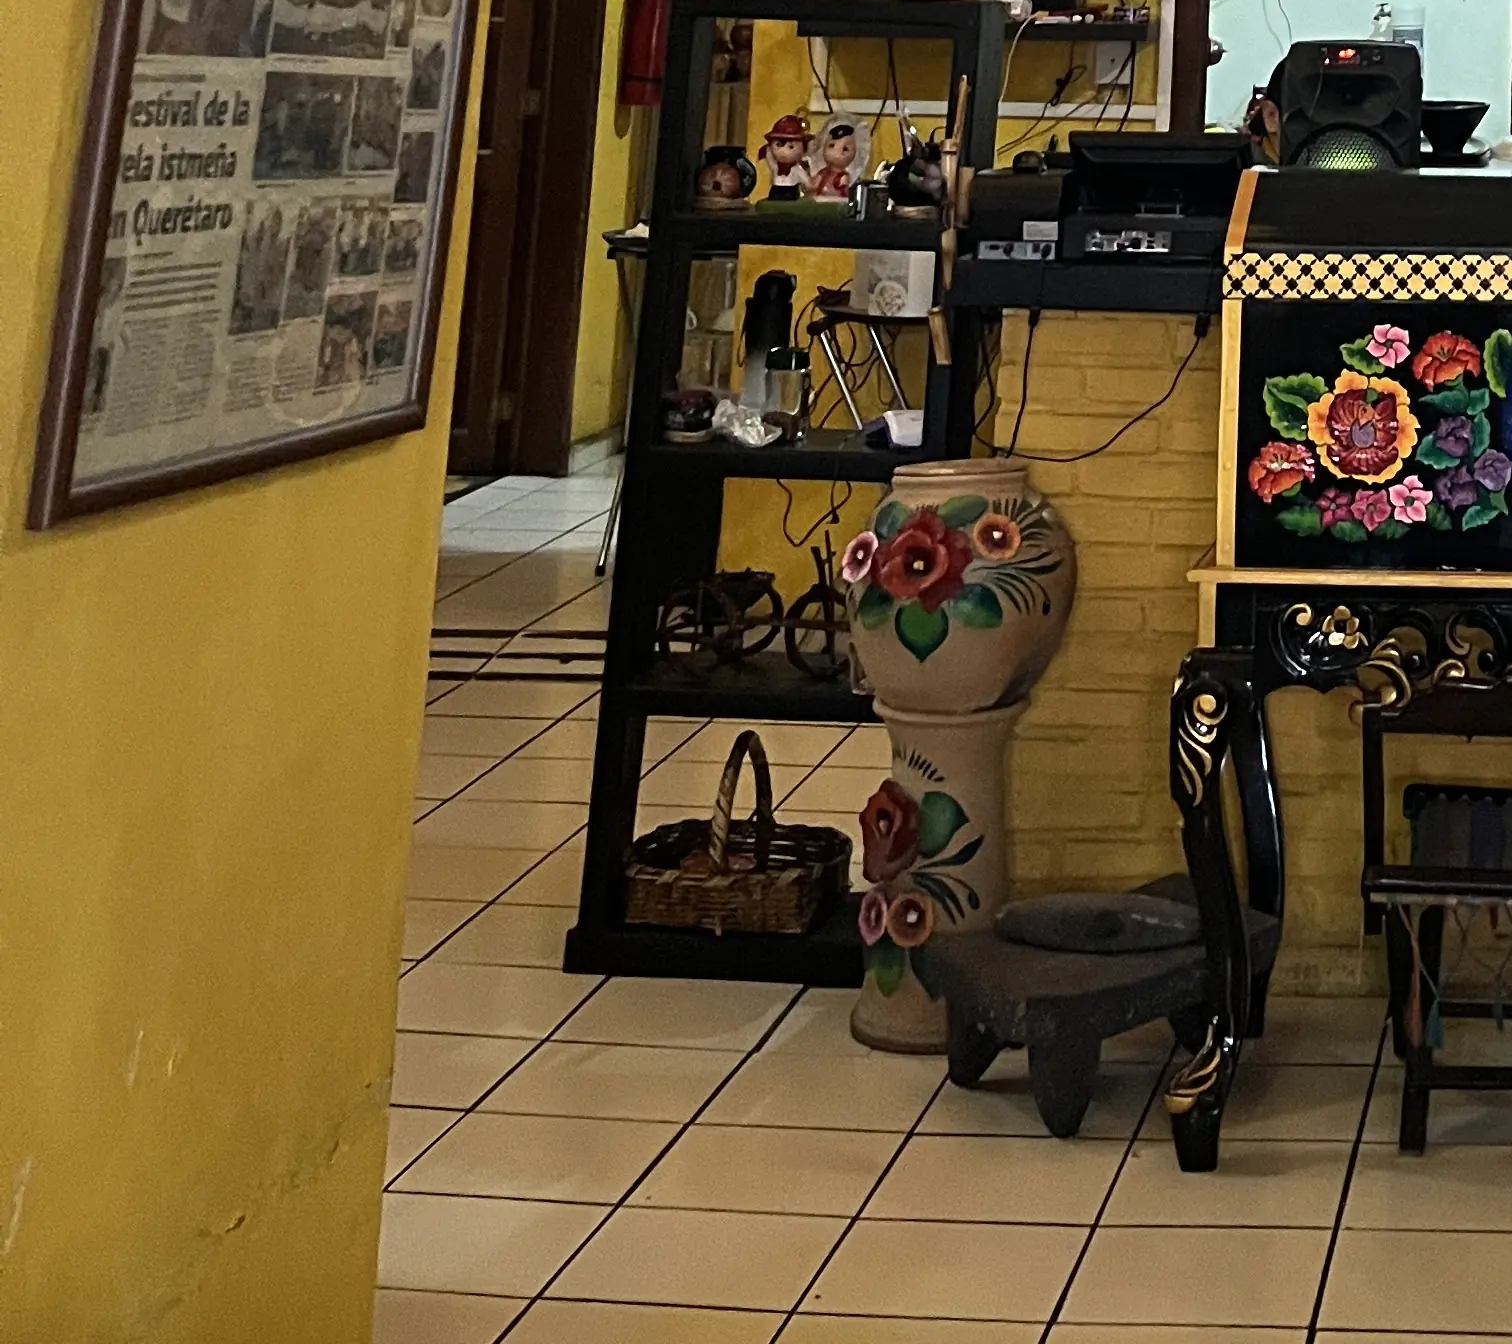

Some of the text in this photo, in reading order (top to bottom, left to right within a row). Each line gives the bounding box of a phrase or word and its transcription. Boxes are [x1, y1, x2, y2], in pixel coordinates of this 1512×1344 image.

[129, 89, 250, 128] estival de la
[121, 141, 237, 184] ela istmeña
[109, 194, 234, 247] n Querétaro
